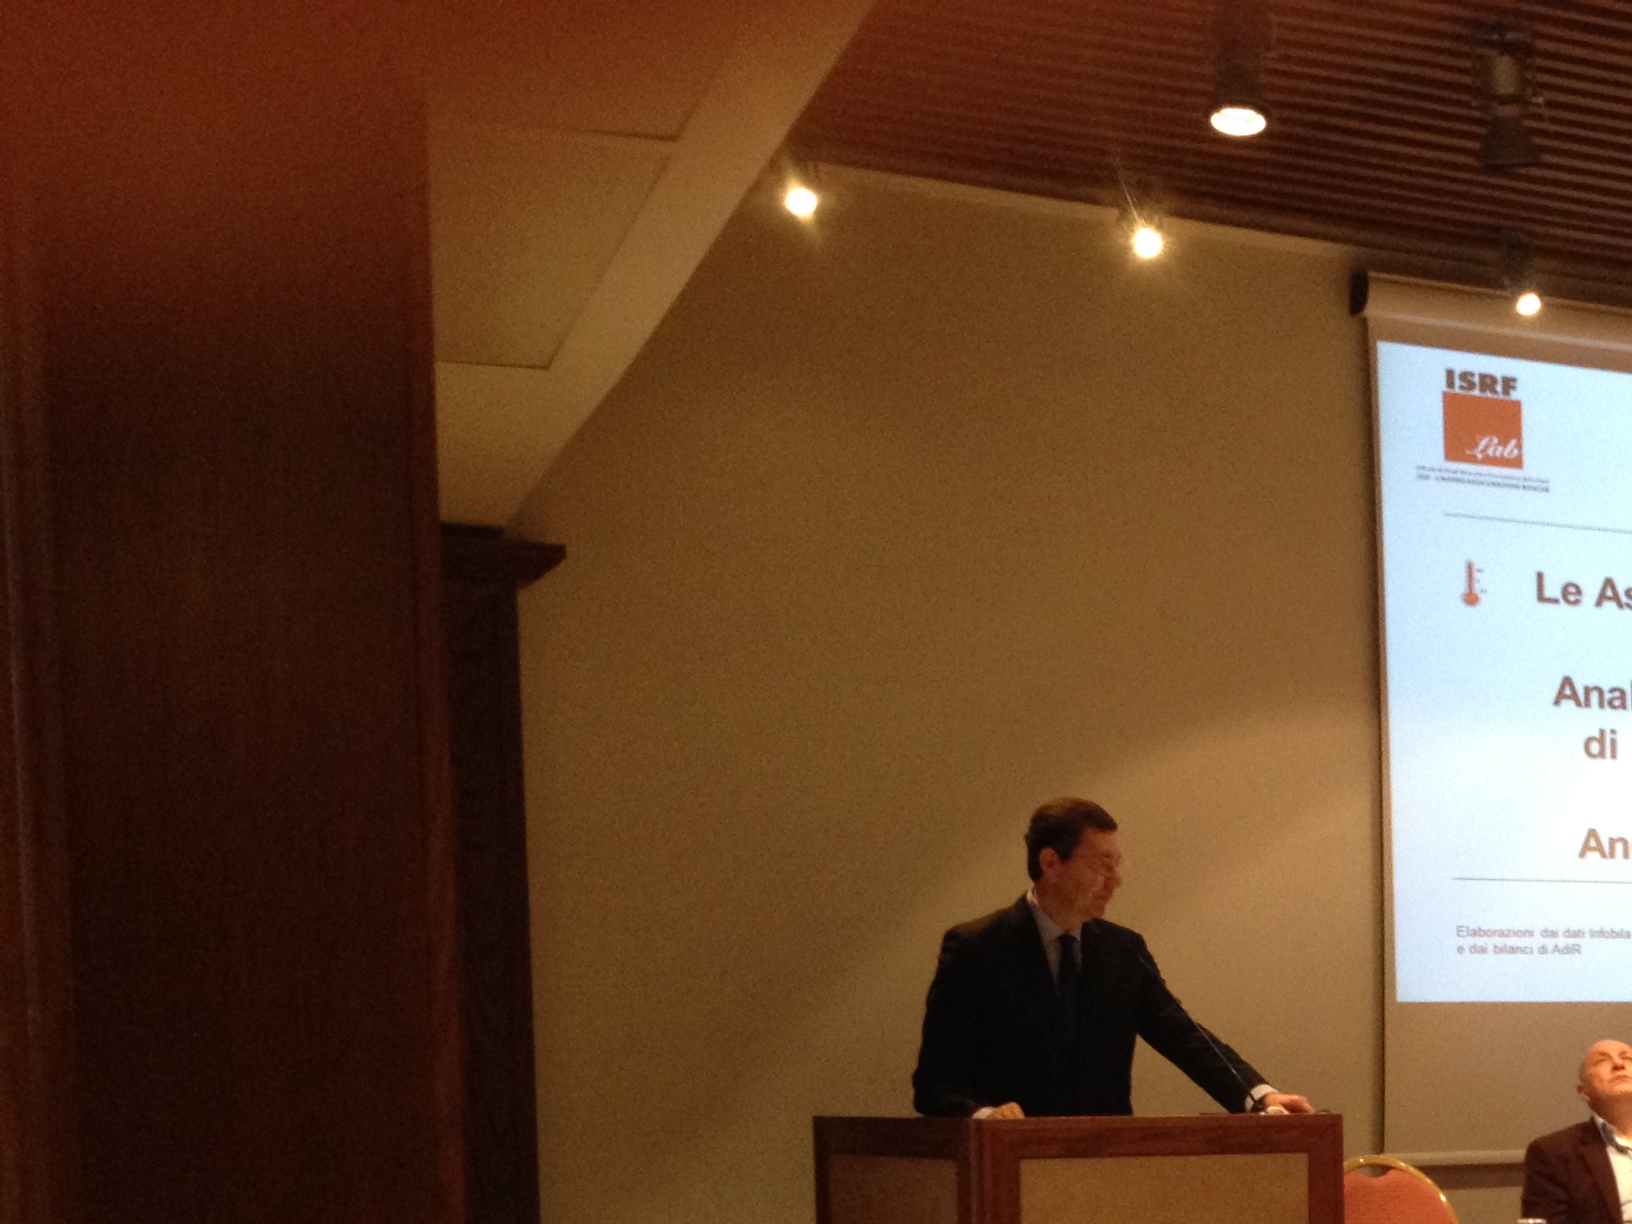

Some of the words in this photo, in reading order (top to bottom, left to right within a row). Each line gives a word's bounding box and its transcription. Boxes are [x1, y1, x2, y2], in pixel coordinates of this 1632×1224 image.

[1445, 369, 1517, 396] ISRF
[1466, 436, 1520, 459] Lab
[1536, 571, 1582, 606] Le
[1583, 729, 1618, 760] di
[1456, 925, 1534, 938] Elaborazioni
[1540, 926, 1559, 938] dai
[1563, 927, 1585, 938] dati
[1457, 946, 1464, 955] e
[1469, 944, 1488, 955] dai
[1493, 944, 1533, 955] bilanci
[1537, 944, 1549, 955] di
